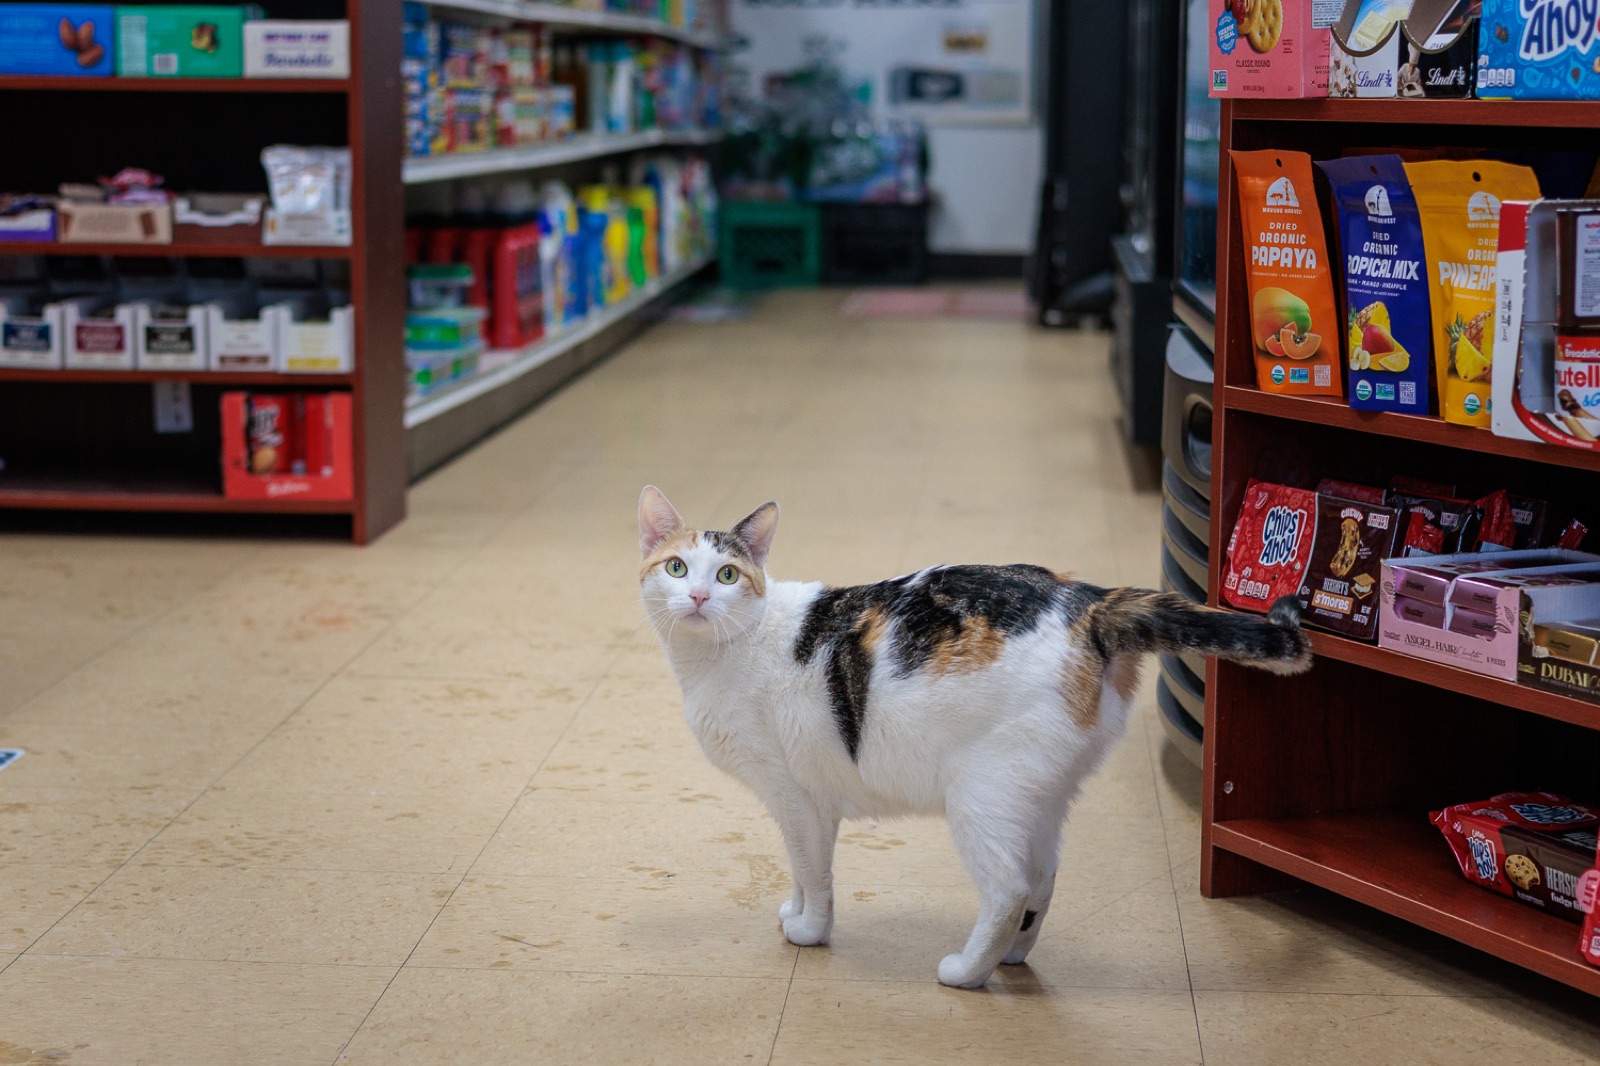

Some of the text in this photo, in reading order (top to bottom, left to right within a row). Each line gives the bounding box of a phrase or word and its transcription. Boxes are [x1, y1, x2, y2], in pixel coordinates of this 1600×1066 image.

[1522, 0, 1600, 56] Ahoy
[1235, 60, 1271, 68] CLASSIC ROUND
[1356, 70, 1385, 88] Lindt
[1425, 67, 1458, 86] Lindt
[1269, 222, 1298, 231] DRIED
[1259, 231, 1307, 245] ORGANIC
[1251, 245, 1317, 269] PAPAYA
[1362, 241, 1399, 256] ORGANIC
[1391, 259, 1420, 281] MIX
[1361, 279, 1380, 288] MANGO
[1555, 364, 1600, 388] utell
[1341, 507, 1364, 522] CHEWY
[1263, 507, 1299, 542] Chips
[1314, 593, 1350, 612] s'mores
[1404, 633, 1435, 649] ANGEL
[1435, 641, 1458, 655] HAIR
[1490, 657, 1507, 667] PIECES
[1540, 662, 1588, 688] DUBAI
[1467, 837, 1491, 863] hips
[1545, 866, 1579, 898] HERSH
[1550, 892, 1574, 909] fudge
[1582, 875, 1599, 909] LIFT
